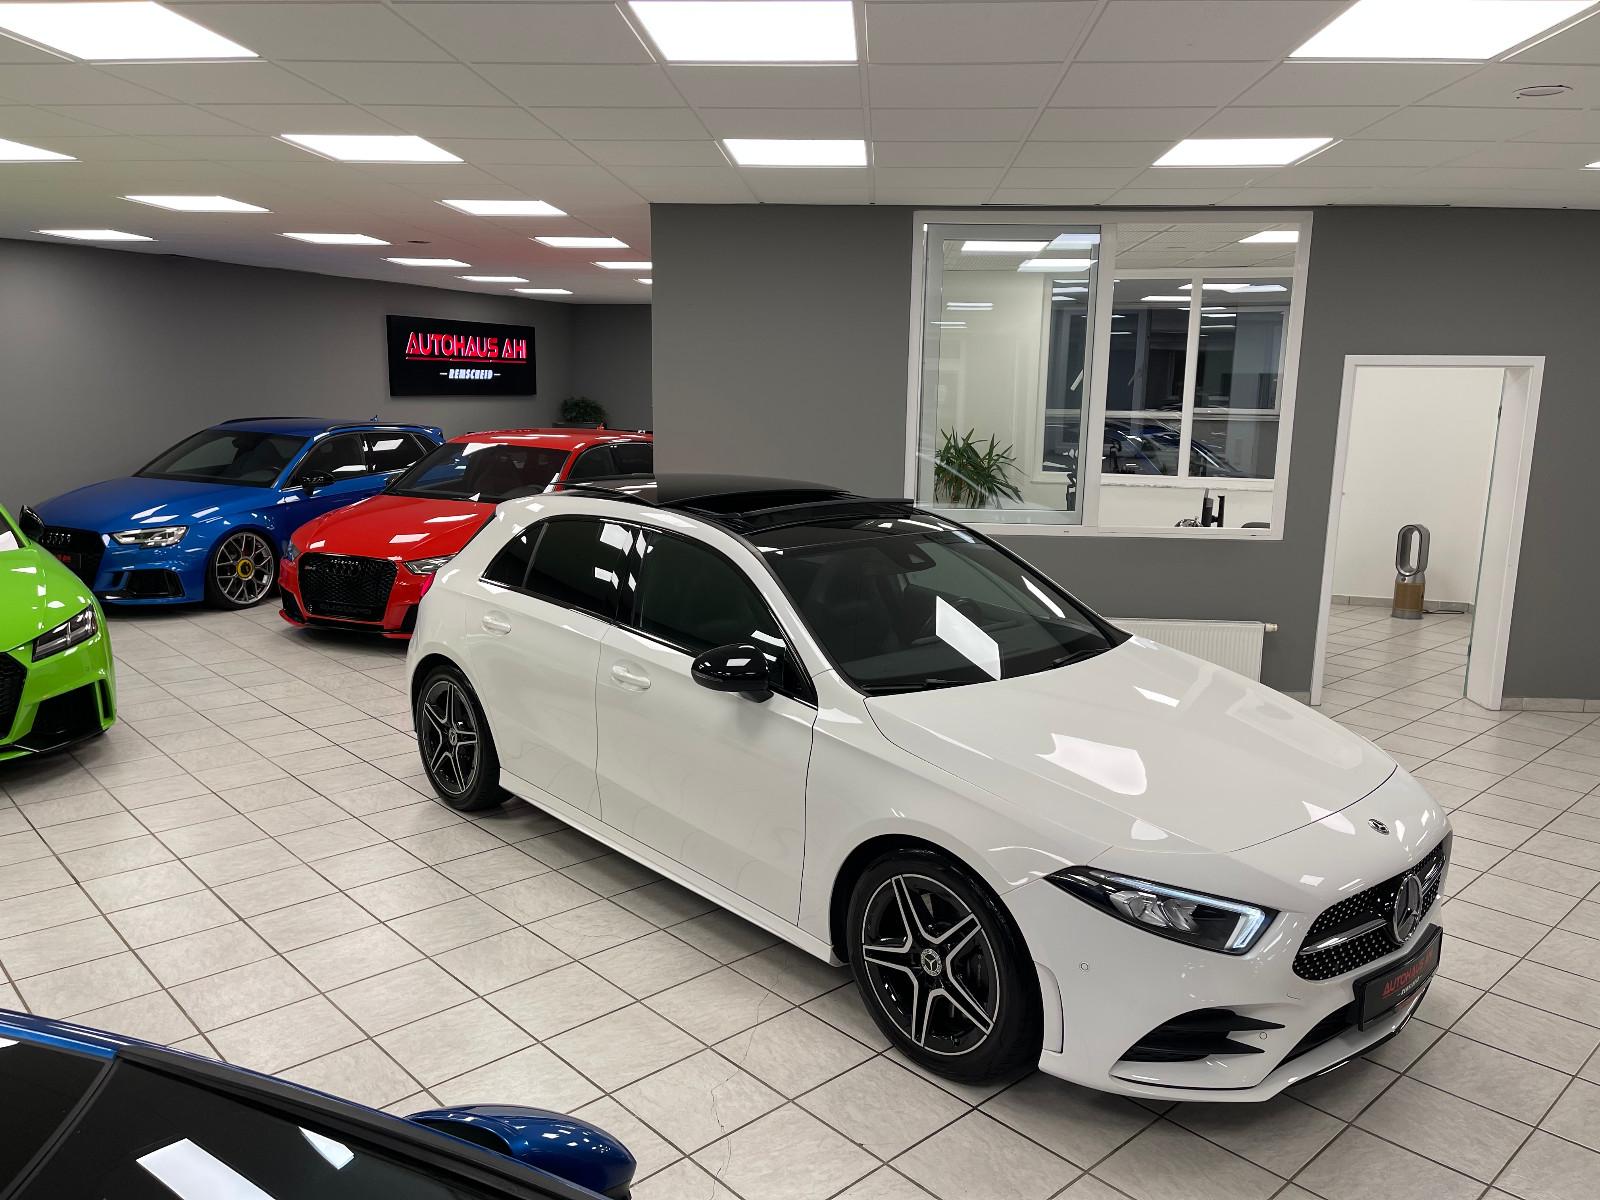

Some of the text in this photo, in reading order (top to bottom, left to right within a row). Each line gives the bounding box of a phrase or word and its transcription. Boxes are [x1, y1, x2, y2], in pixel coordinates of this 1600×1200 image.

[405, 331, 527, 359] AUTOHAUS AH
[449, 369, 493, 380] REMSCHEID
